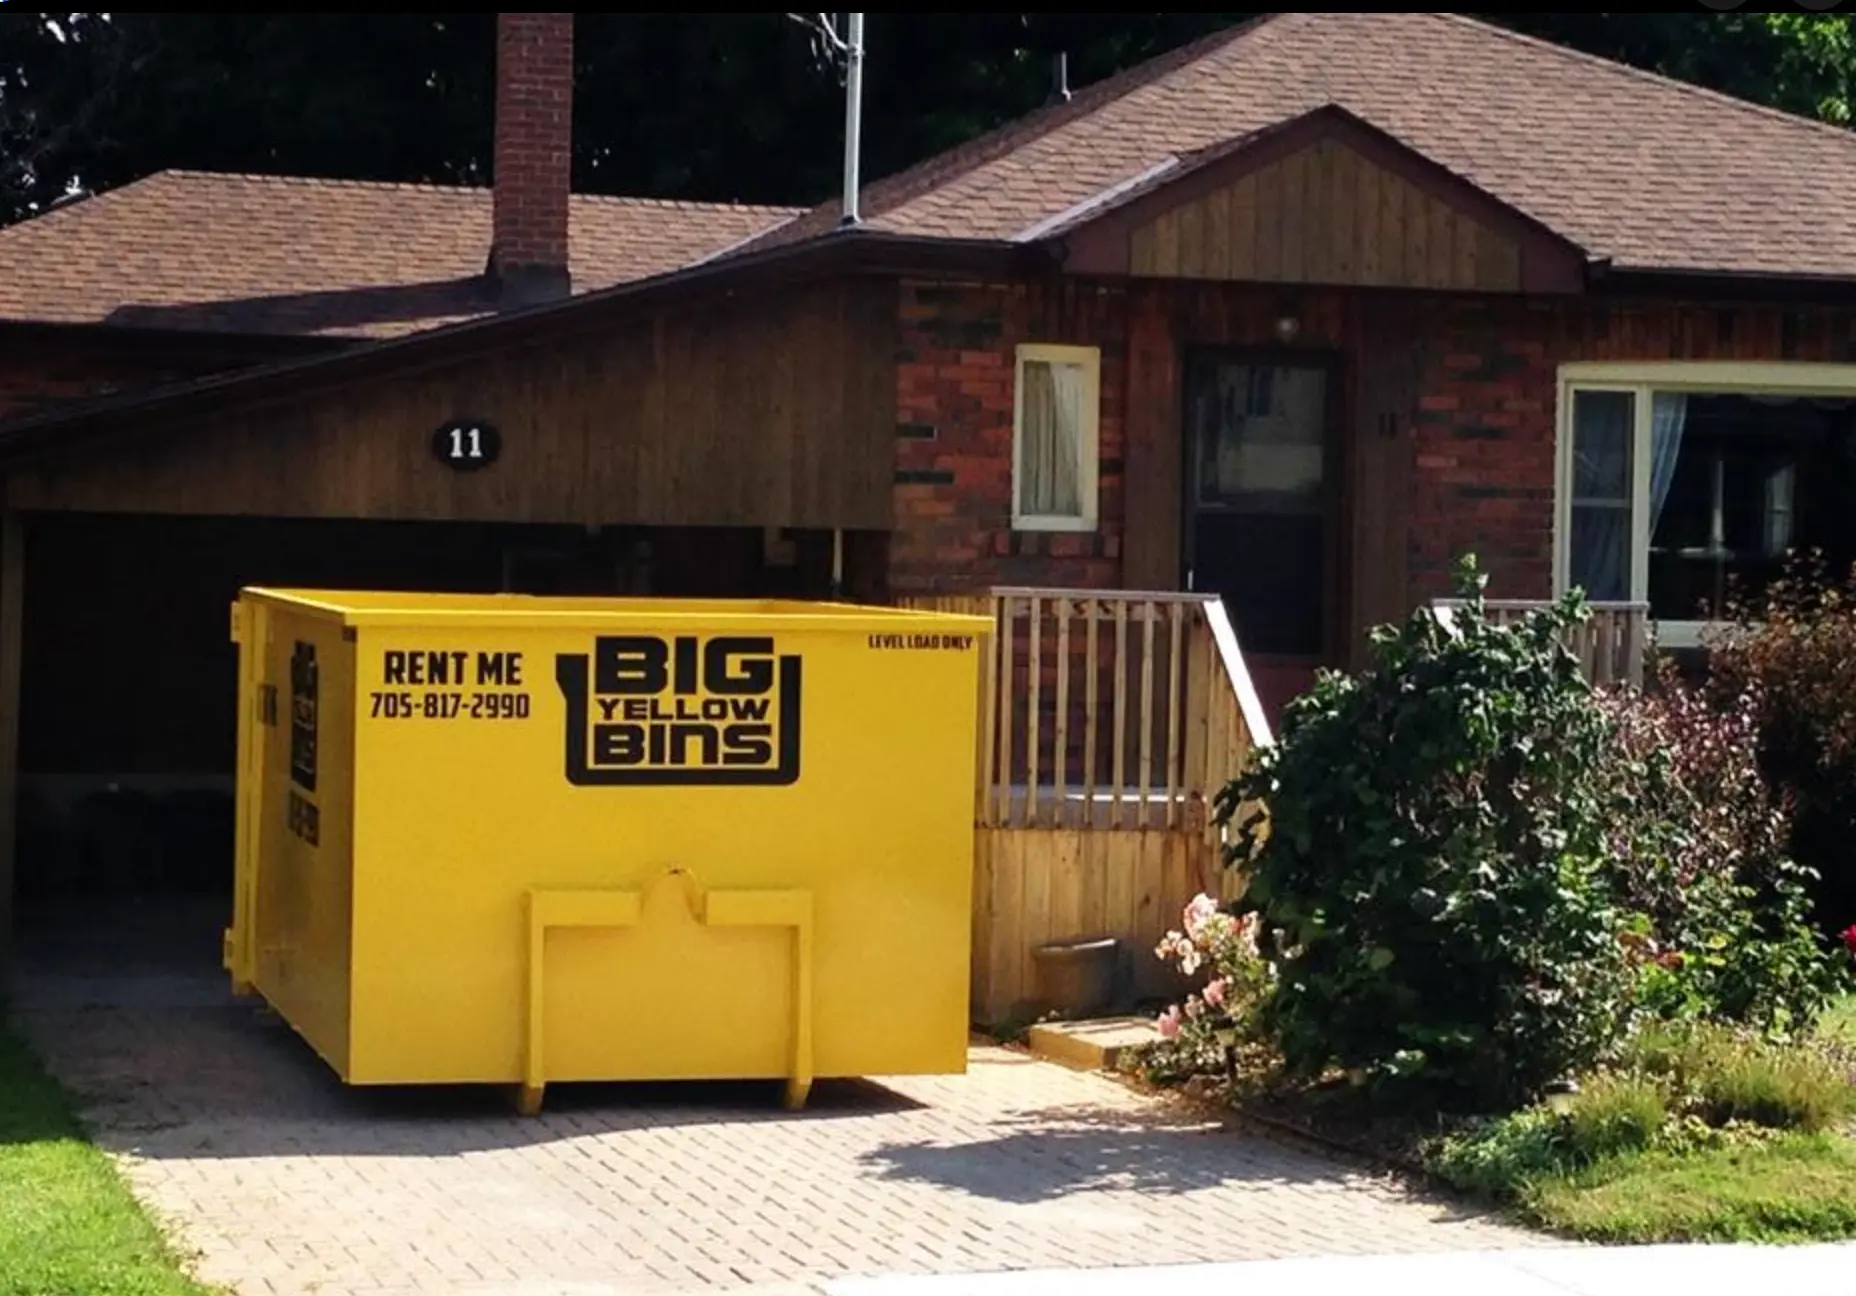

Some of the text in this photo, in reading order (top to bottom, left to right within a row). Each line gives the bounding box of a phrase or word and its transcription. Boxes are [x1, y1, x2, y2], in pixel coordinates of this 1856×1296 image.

[450, 428, 482, 457] 11
[384, 650, 523, 685] RENT ME
[595, 636, 774, 695] BIG
[370, 692, 530, 719] 705-817-2990
[596, 698, 770, 721] YELLOW
